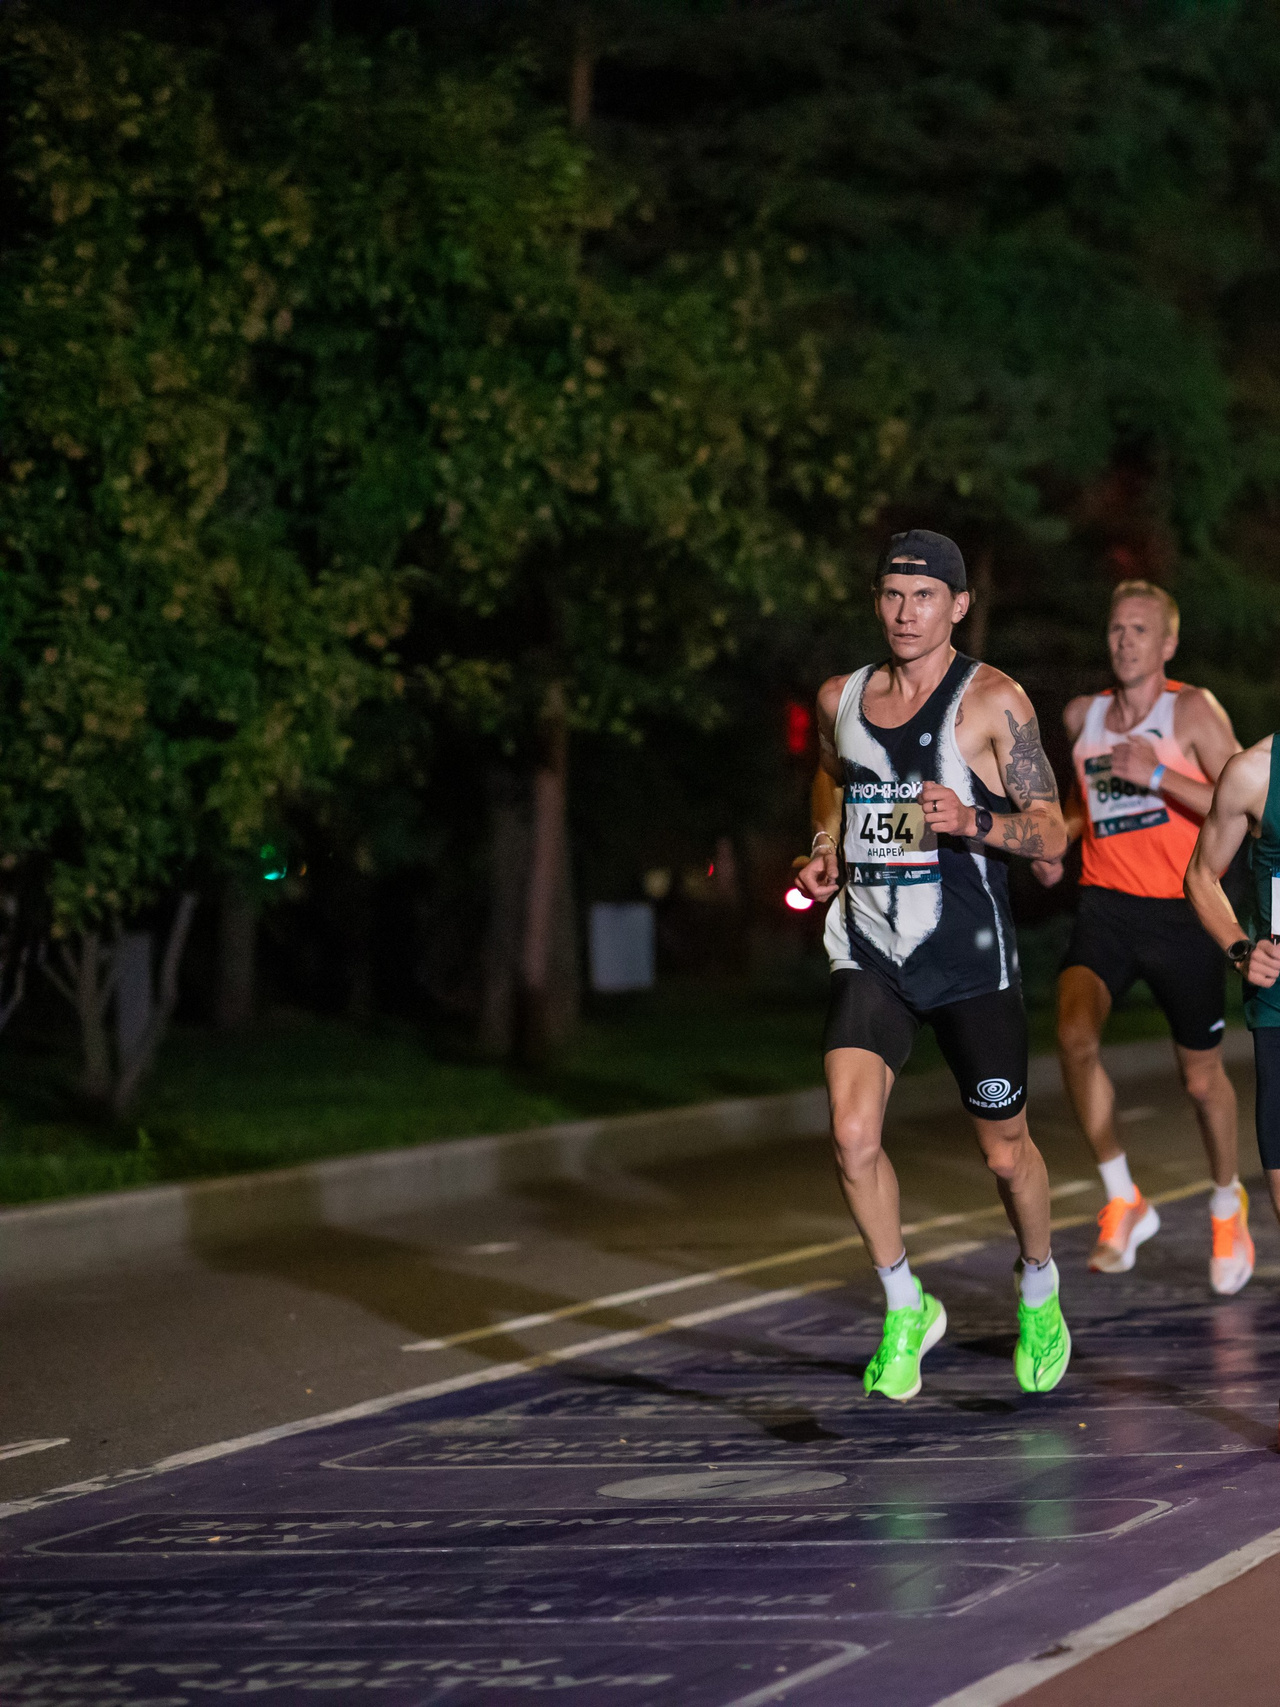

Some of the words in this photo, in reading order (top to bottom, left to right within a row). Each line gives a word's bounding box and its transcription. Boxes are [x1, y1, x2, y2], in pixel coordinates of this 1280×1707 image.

[860, 812, 913, 843] 454
[867, 846, 905, 858] АНДРЕЙ
[969, 1086, 1023, 1108] INSANITY
[158, 1520, 434, 1532] Затем
[446, 1511, 949, 1528] поменяйте
[117, 1534, 335, 1545] ногу
[238, 1657, 564, 1673] пятку
